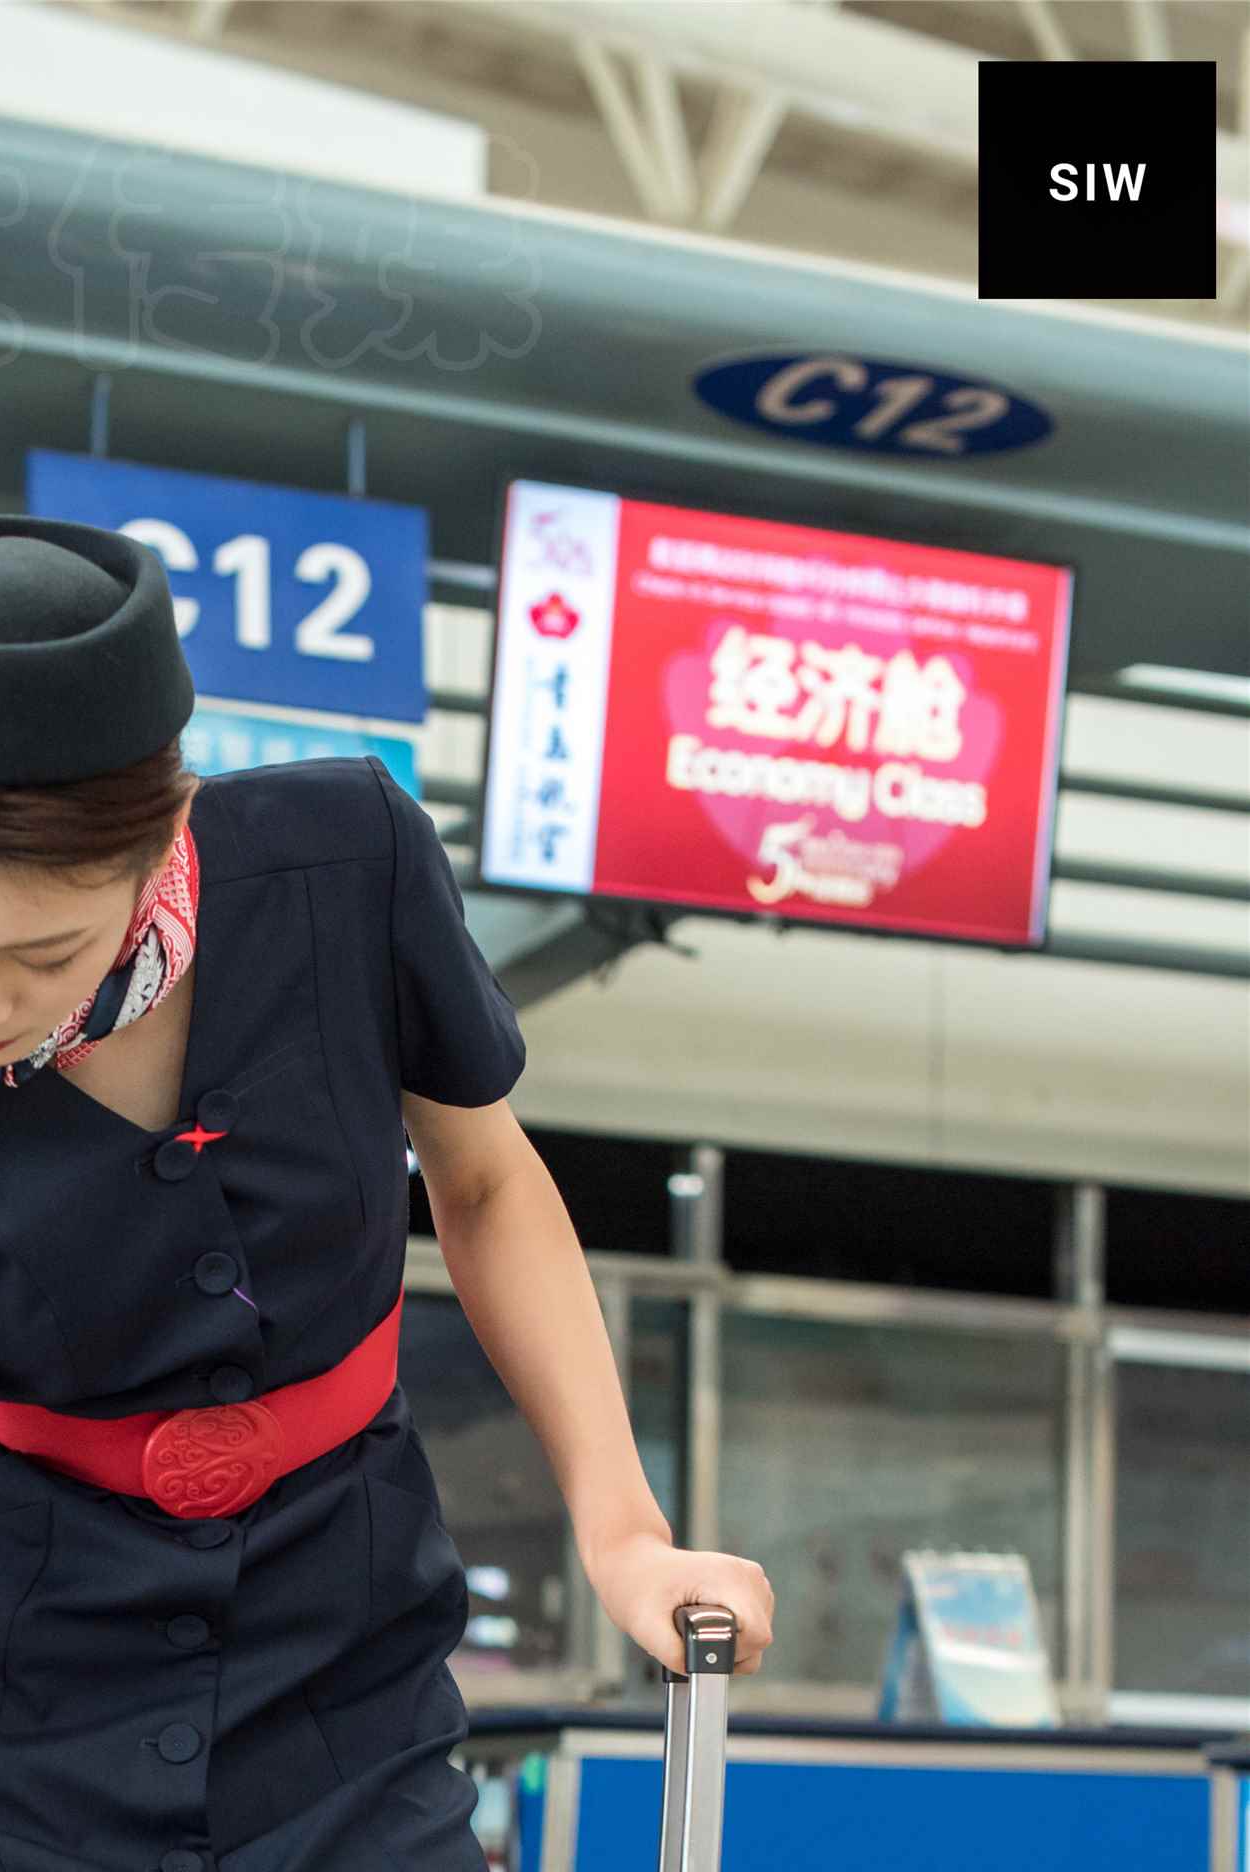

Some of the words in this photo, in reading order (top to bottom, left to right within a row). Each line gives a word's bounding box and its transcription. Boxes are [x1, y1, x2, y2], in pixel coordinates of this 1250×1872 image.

[754, 356, 1012, 452] C12
[706, 625, 967, 764] 经济舱
[665, 733, 872, 823] Economy
[873, 761, 989, 829] Class
